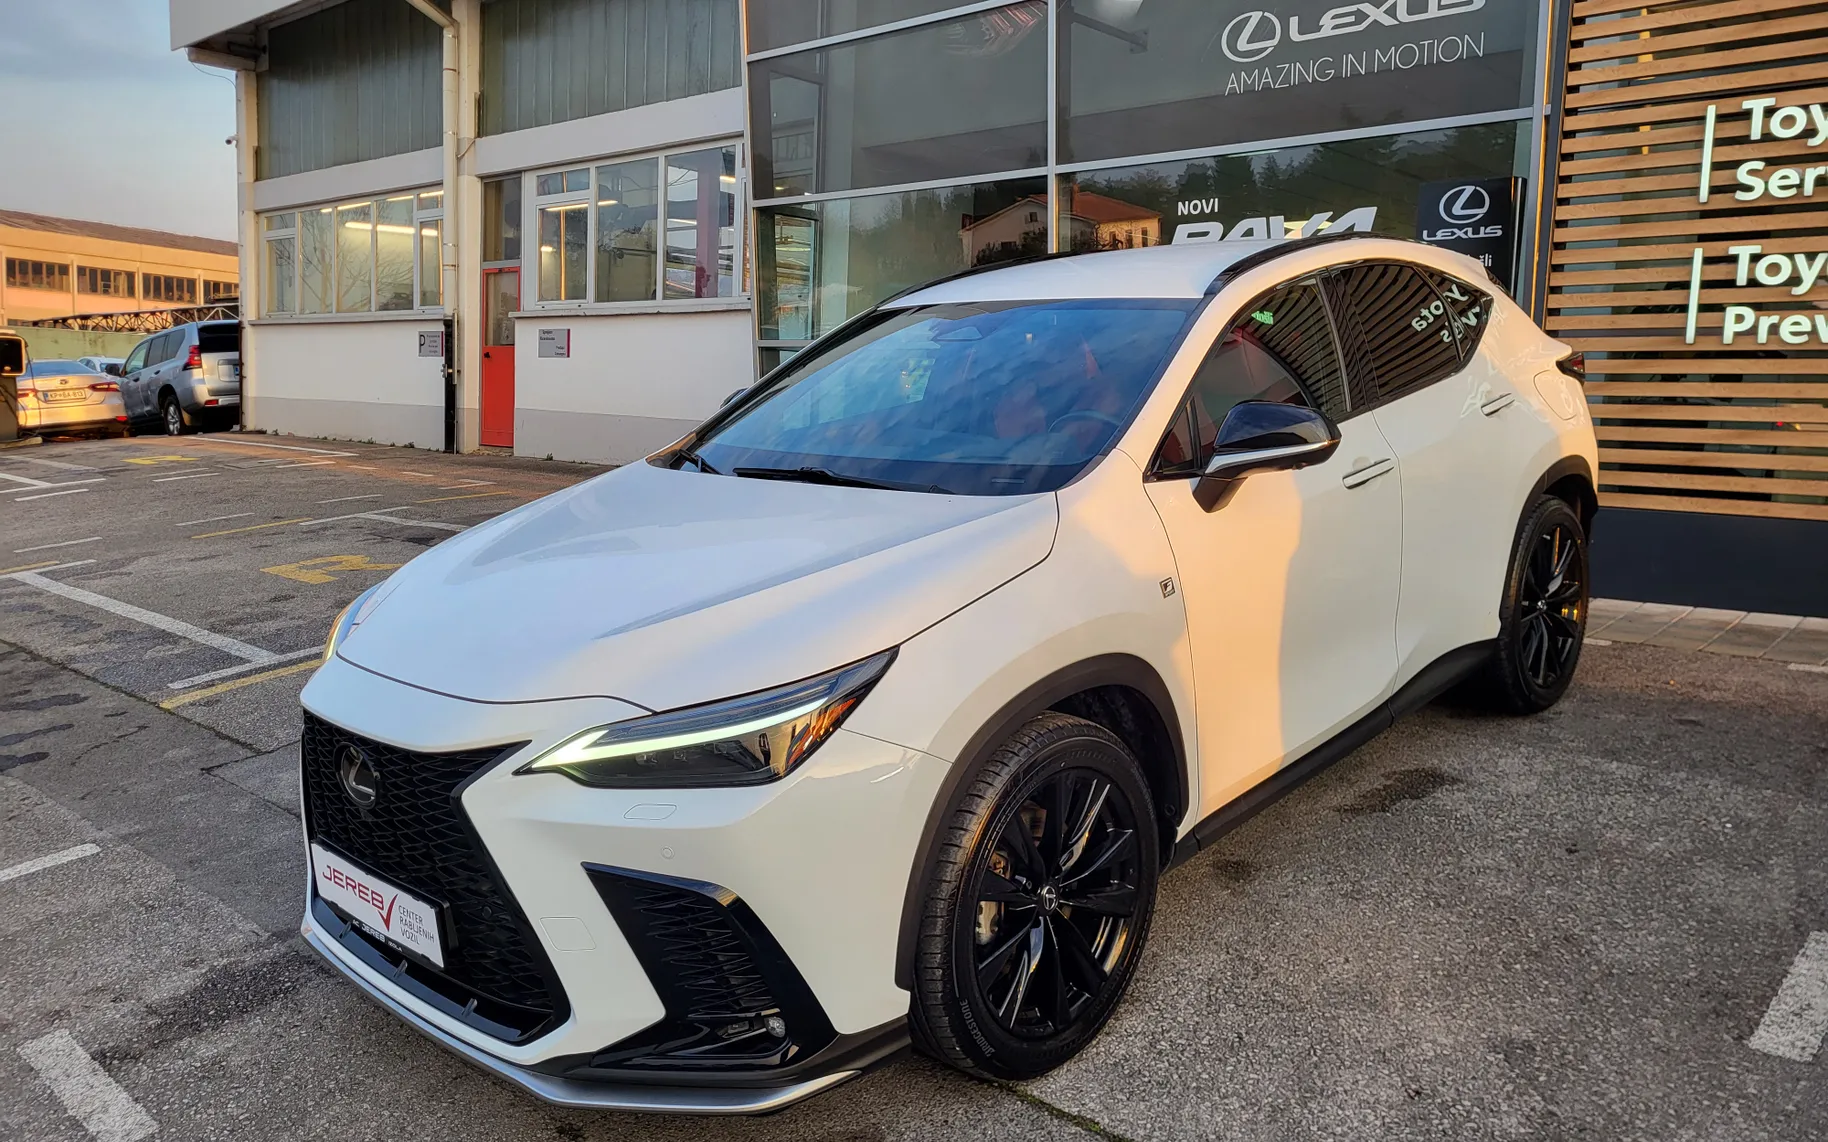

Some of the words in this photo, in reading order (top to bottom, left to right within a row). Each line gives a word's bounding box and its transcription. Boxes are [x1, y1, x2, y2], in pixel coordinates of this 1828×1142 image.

[1225, 57, 1335, 96] AMAZING
[1342, 51, 1366, 78] IN
[1375, 32, 1485, 73] MOTION
[1734, 160, 1828, 201] Ser
[1177, 198, 1219, 216] NOVI
[1422, 225, 1503, 241] LEXUS
[1728, 245, 1828, 295] Toy
[322, 865, 385, 911] JEREB
[398, 905, 424, 926] CENTER
[361, 924, 386, 943] JEREB
[399, 916, 435, 943] RABLJENIH
[400, 928, 420, 945] VOZIL
[960, 998, 996, 1058] BRIDGESTONE
